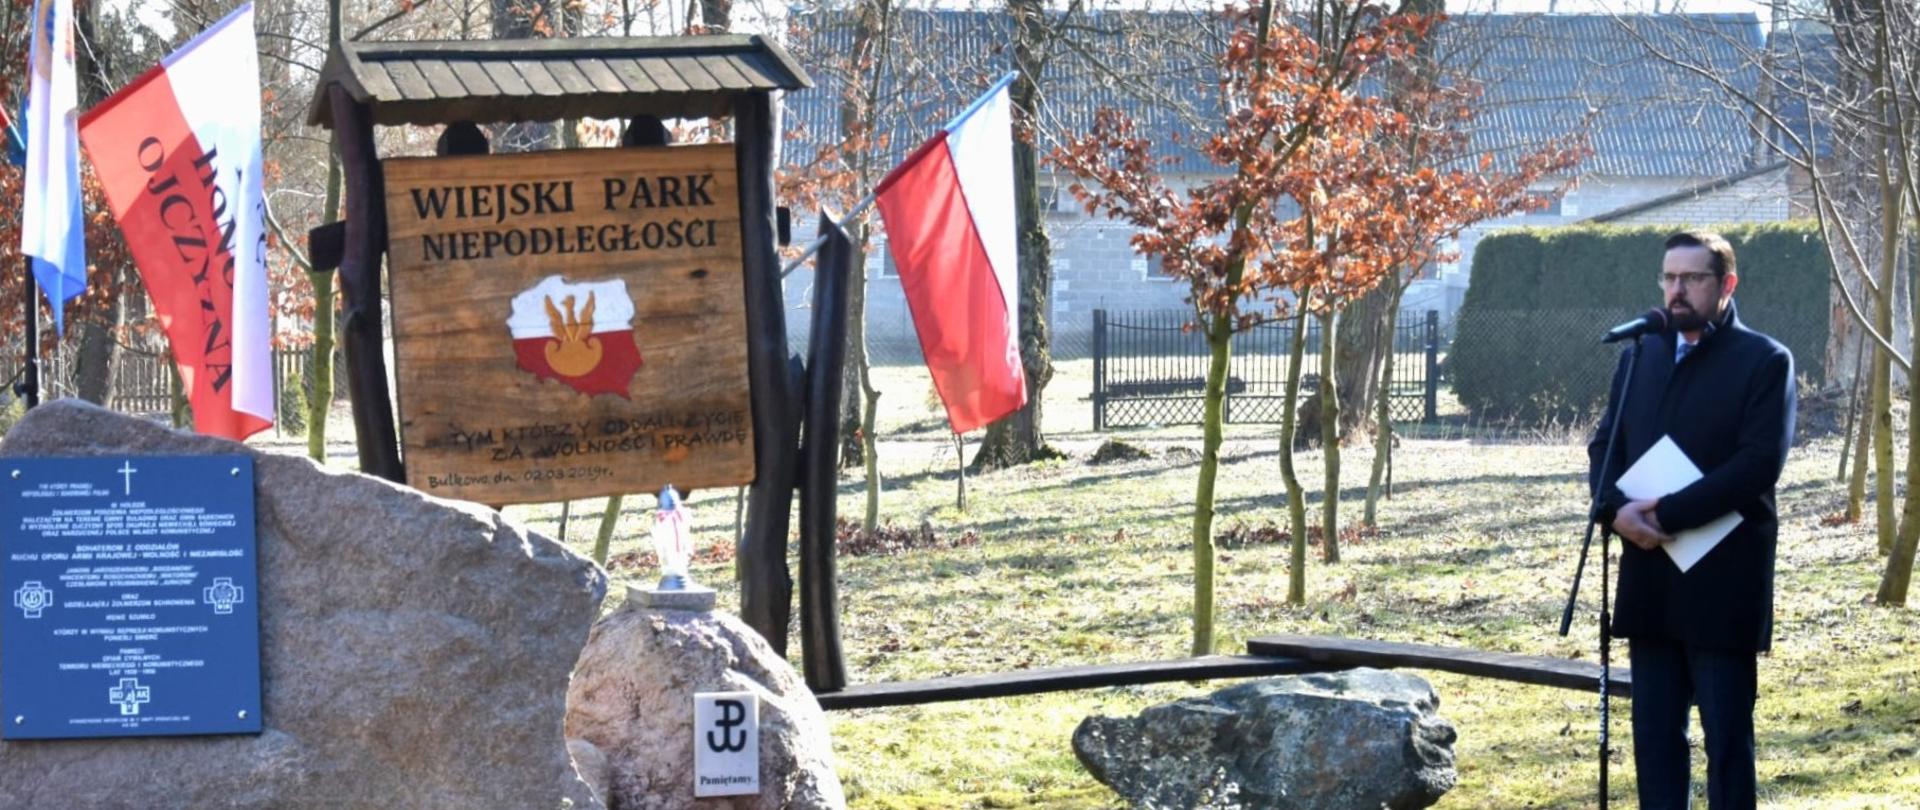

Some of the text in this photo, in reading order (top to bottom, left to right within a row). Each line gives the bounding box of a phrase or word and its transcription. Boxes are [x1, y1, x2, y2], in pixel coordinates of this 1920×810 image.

[410, 173, 715, 224] WIEJSKI PARK
[422, 217, 717, 262] NIEPODLEGŁOŚCI
[492, 445, 523, 462] ZA
[663, 428, 746, 449] PRAWDĘ
[502, 421, 591, 442] KTÓRZY
